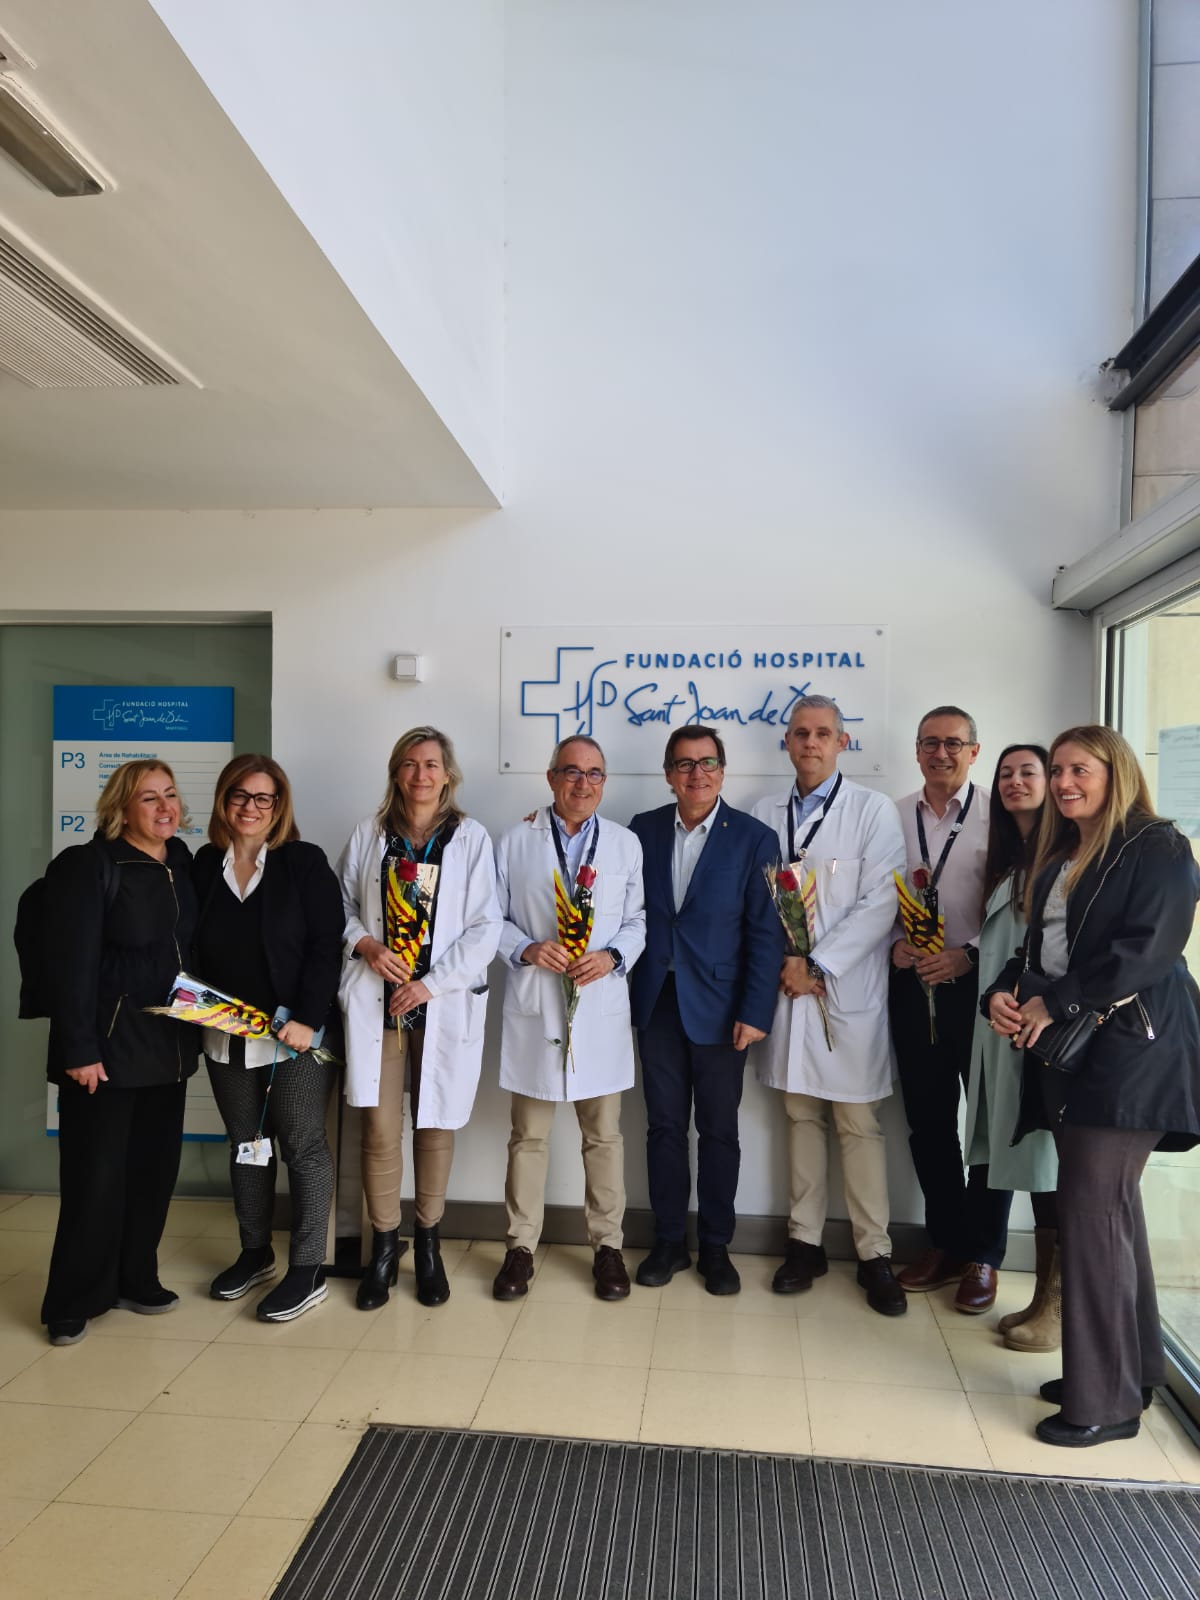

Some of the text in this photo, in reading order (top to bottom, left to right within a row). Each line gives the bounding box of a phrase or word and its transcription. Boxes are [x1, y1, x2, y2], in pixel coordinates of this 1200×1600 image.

[625, 649, 865, 669] FUNDACIÓ HOSPITAL
[623, 682, 687, 727] Sant
[684, 680, 748, 726] Joan
[748, 690, 779, 726] de
[61, 752, 86, 769] P3
[61, 815, 85, 832] P2
